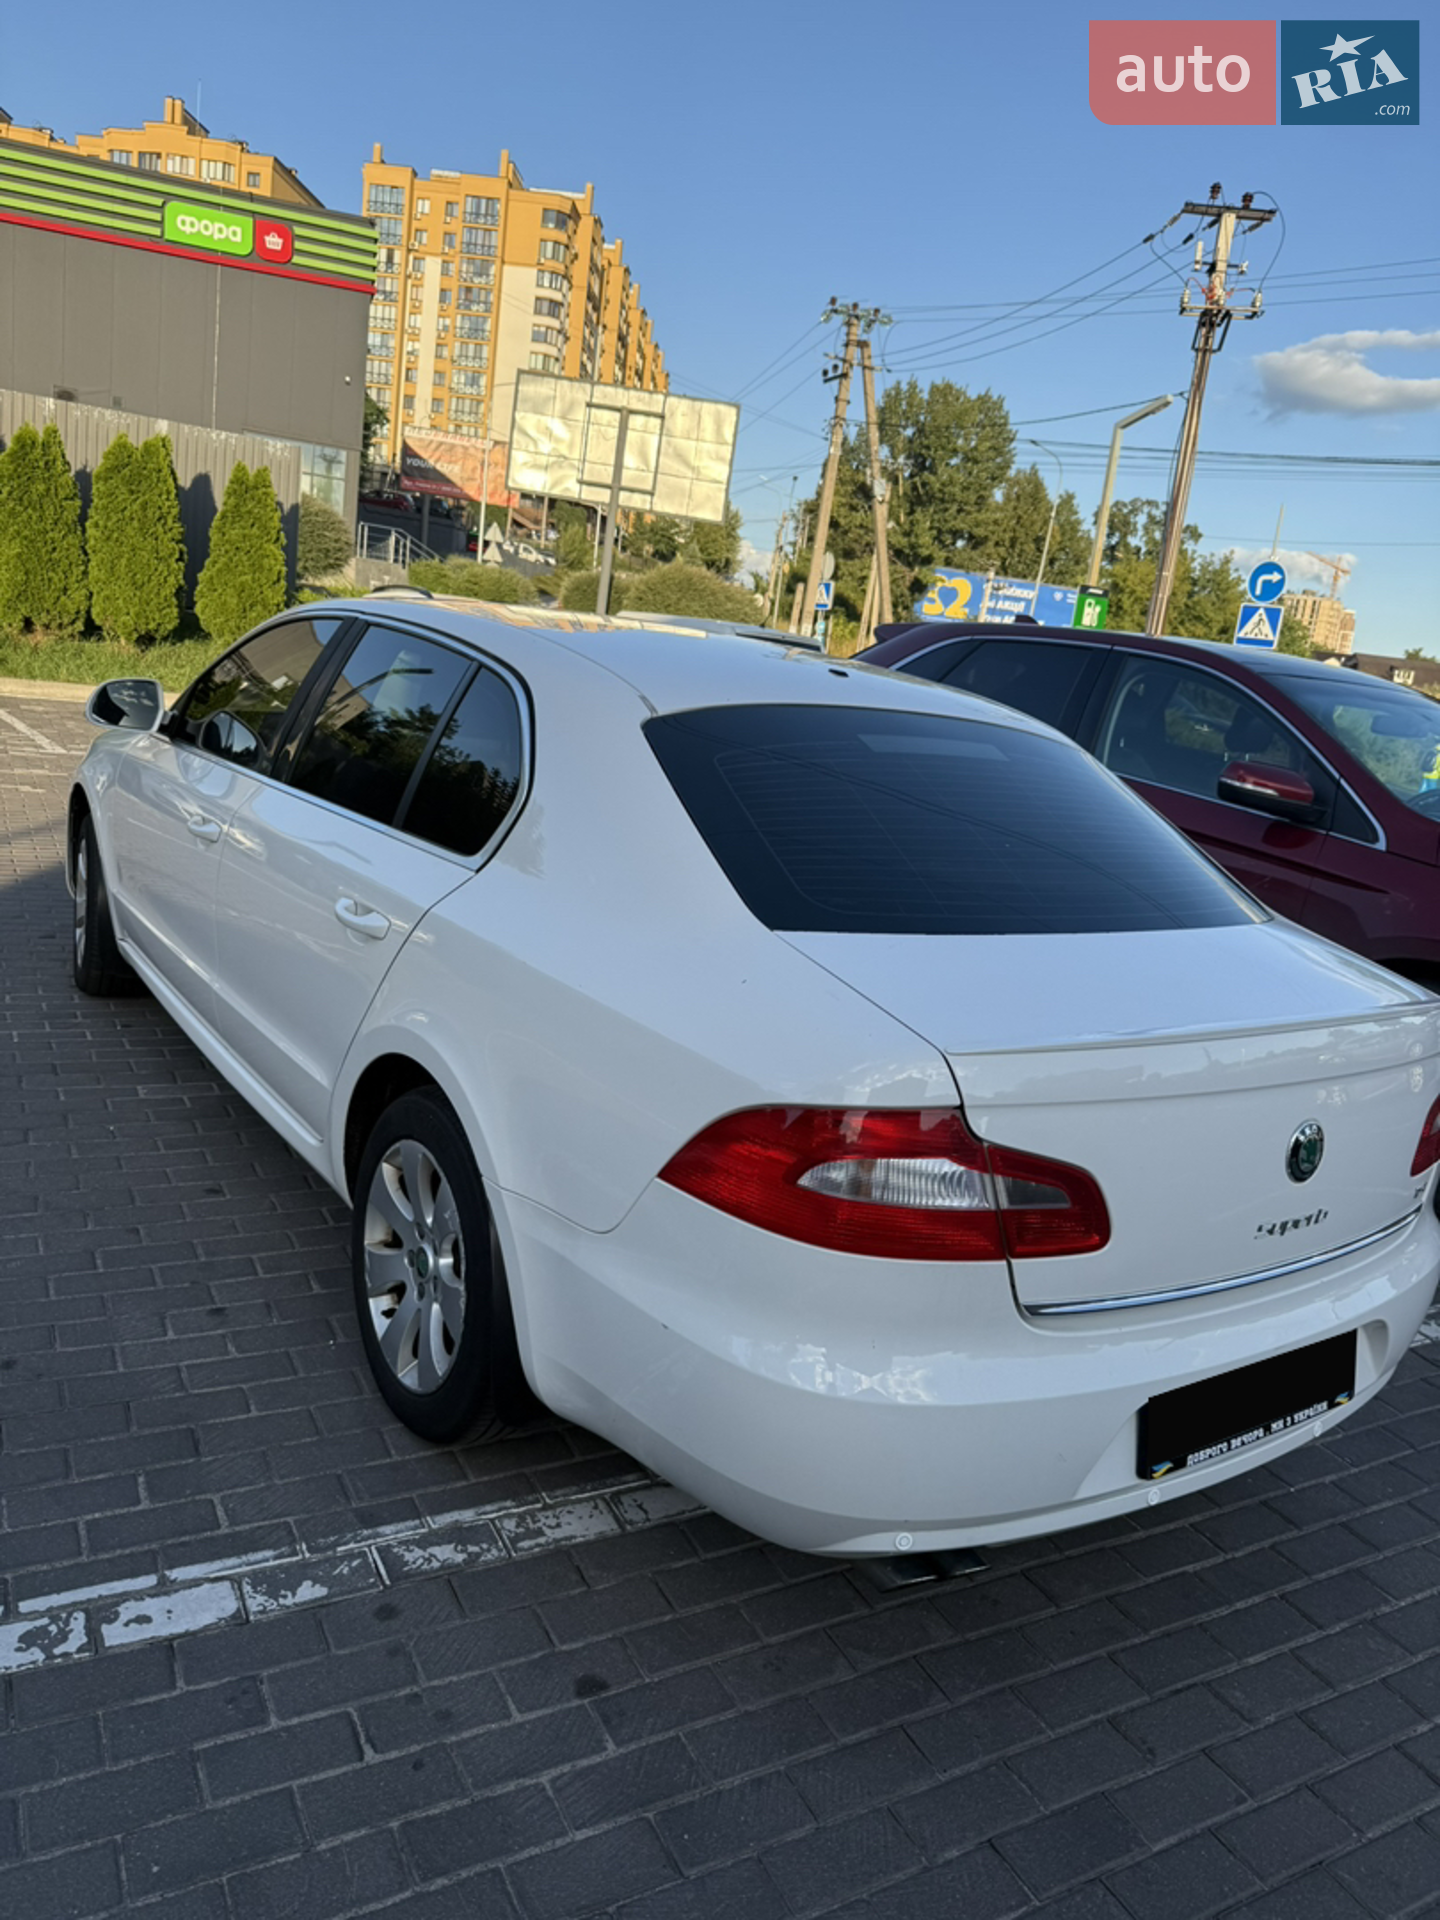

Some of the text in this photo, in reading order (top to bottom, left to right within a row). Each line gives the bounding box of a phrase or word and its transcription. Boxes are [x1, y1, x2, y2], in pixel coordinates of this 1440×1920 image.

[176, 214, 242, 243] фора
[1187, 1442, 1229, 1467] ДОБРОГО
[1293, 1400, 1329, 1424] УКРАЇНИ
